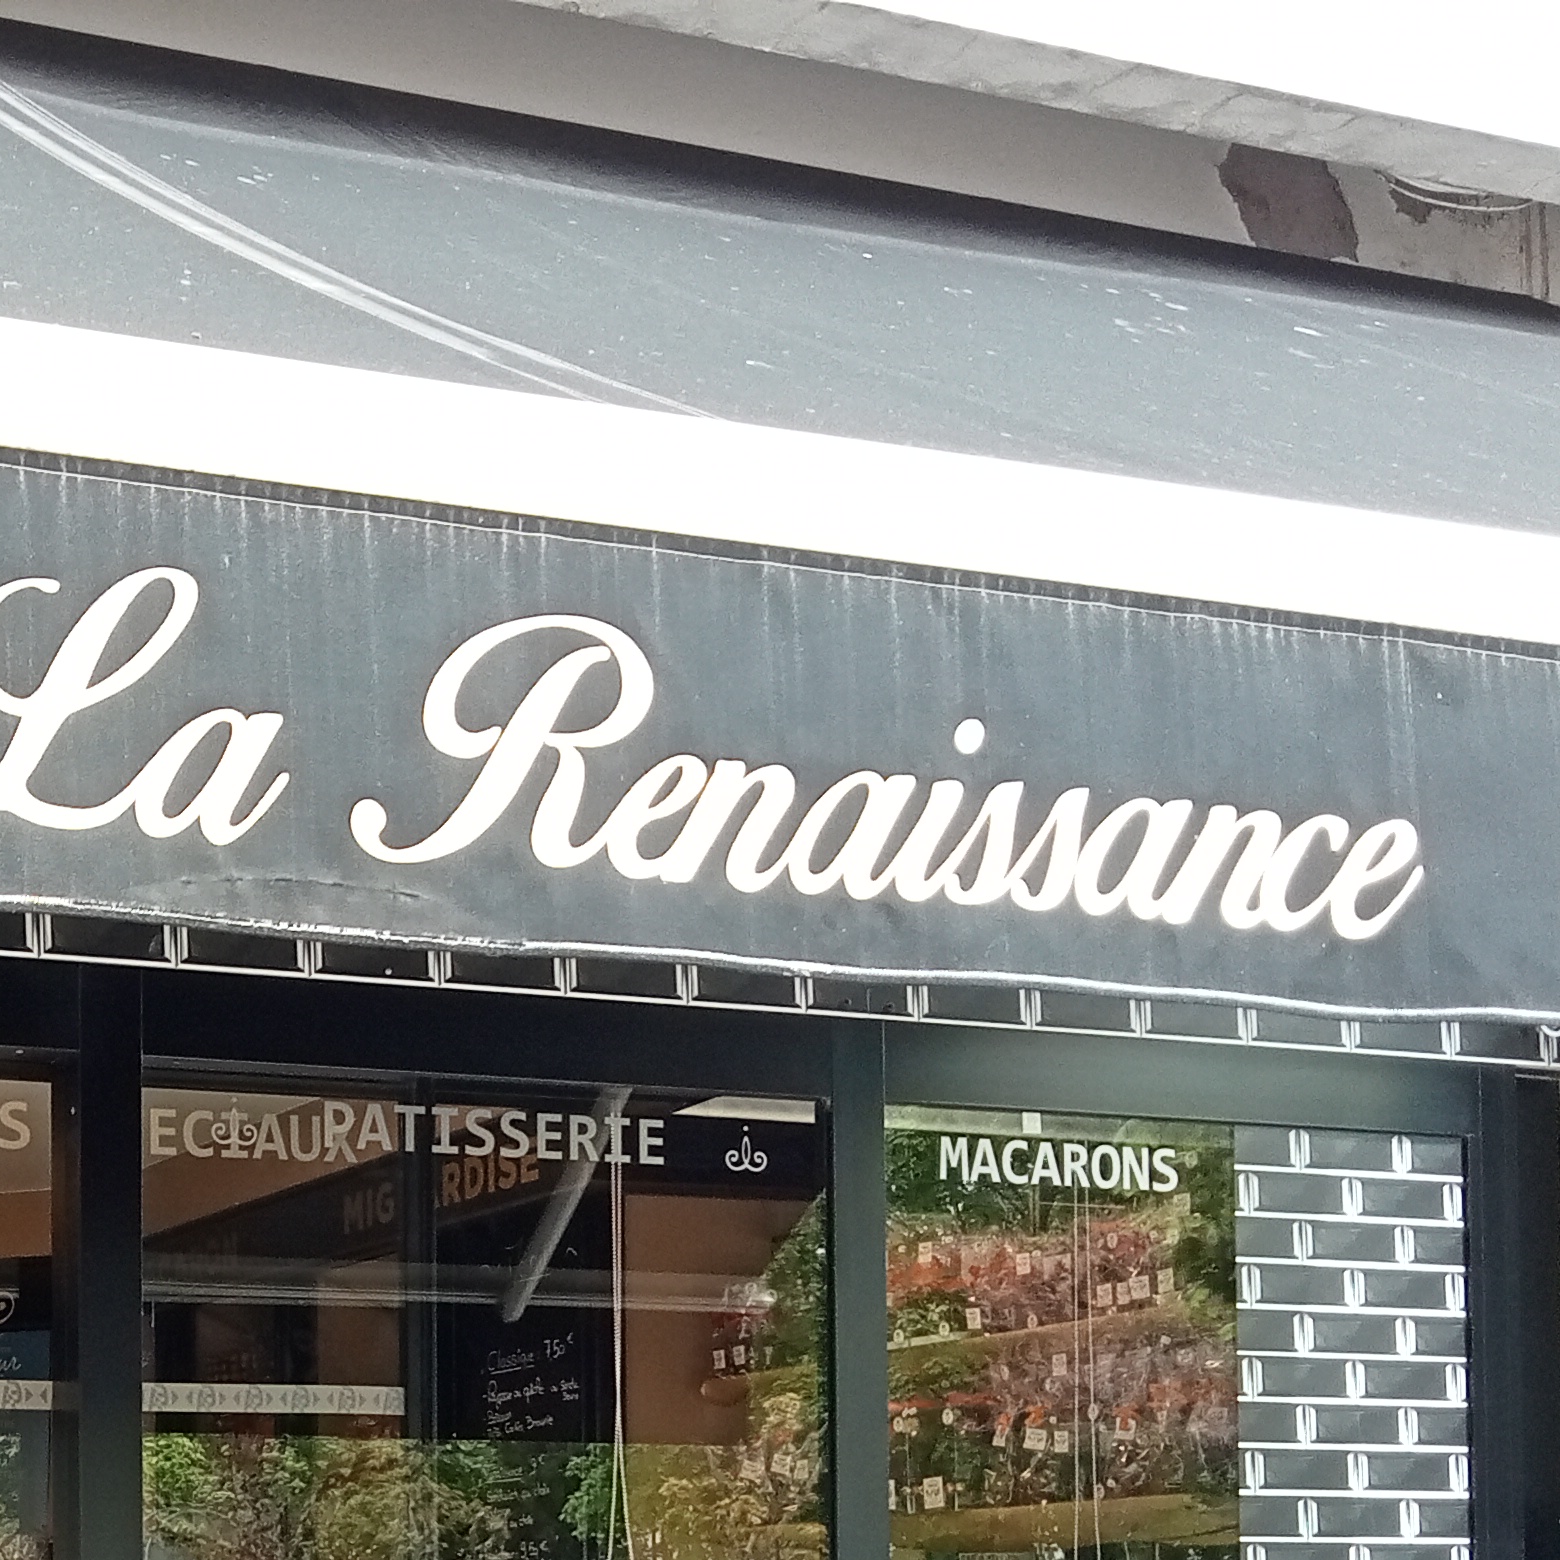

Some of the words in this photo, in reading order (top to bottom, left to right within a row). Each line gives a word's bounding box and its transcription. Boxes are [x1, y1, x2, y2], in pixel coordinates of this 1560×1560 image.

[349, 613, 1426, 942] Renaissance
[148, 1107, 359, 1164] ECIAUX
[323, 1101, 666, 1166] PATISSERIE
[940, 1136, 1179, 1193] MACARONS
